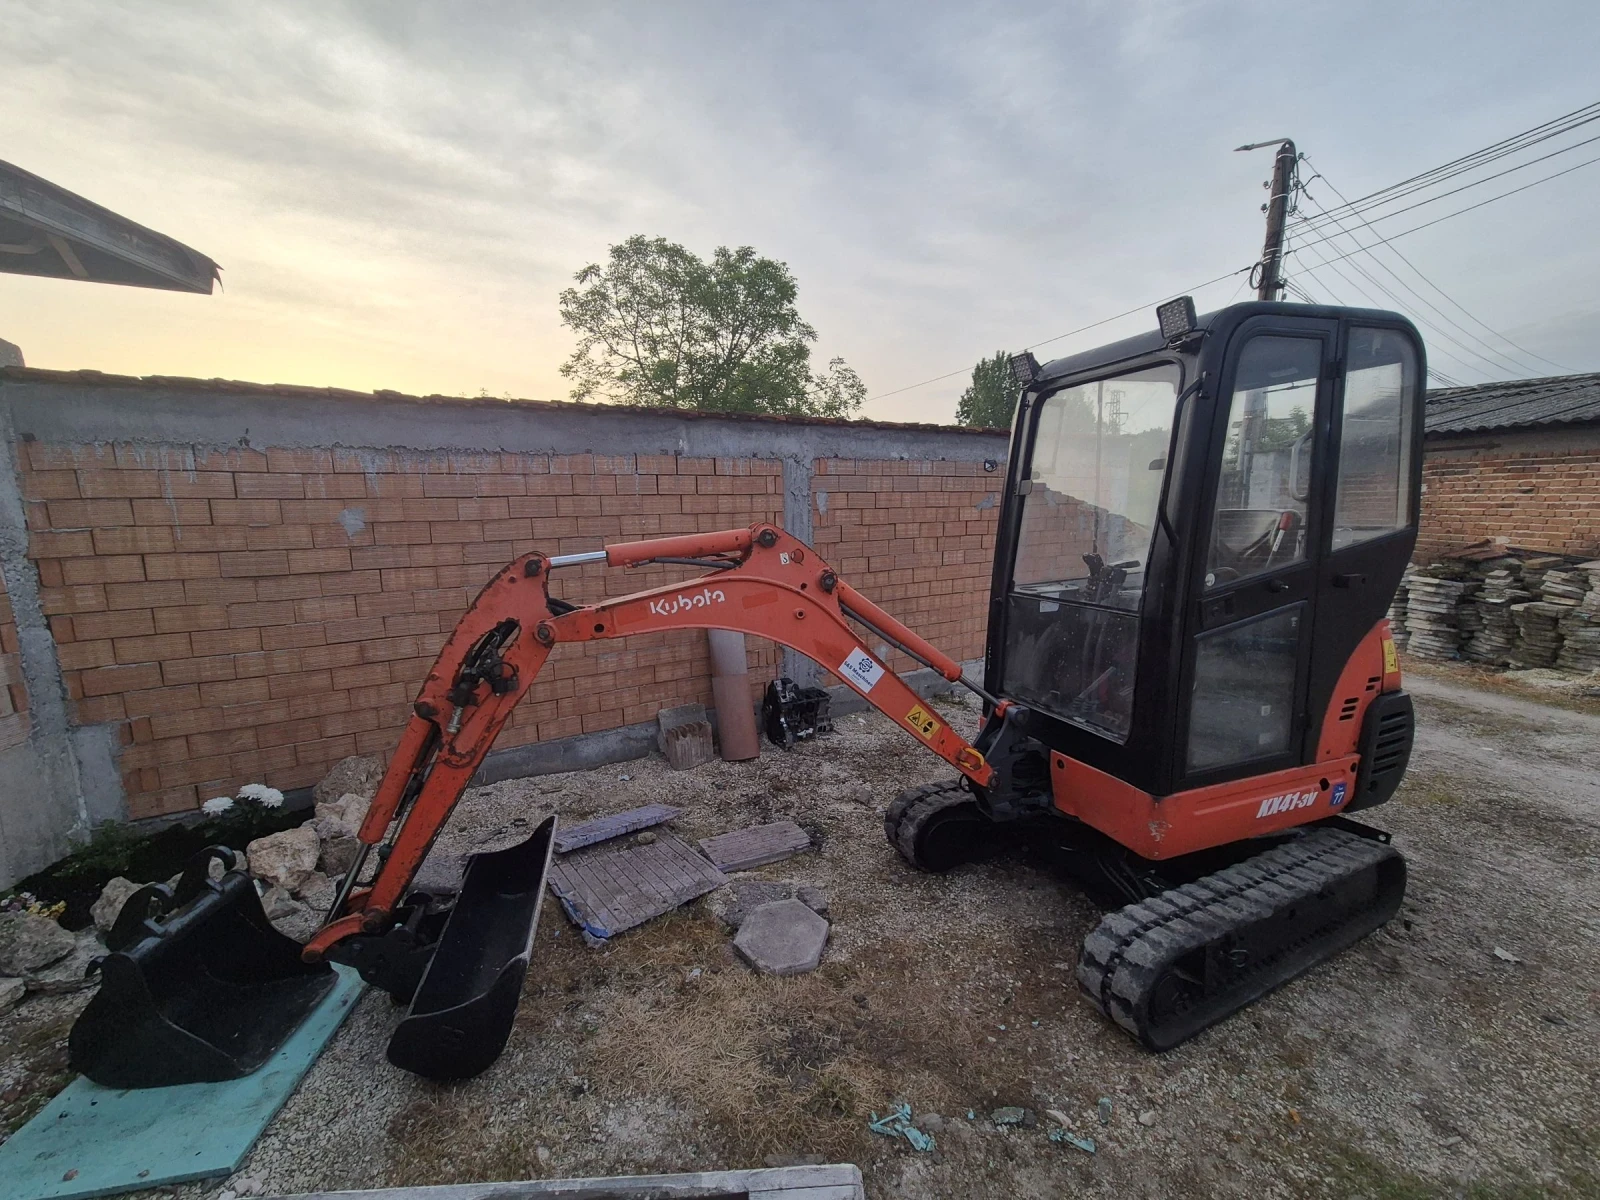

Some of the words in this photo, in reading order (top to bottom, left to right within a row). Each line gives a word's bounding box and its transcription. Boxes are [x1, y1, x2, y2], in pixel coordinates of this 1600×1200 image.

[649, 588, 726, 616] Kubota
[1256, 791, 1319, 819] KX41-3V
[1333, 791, 1345, 805] 77
